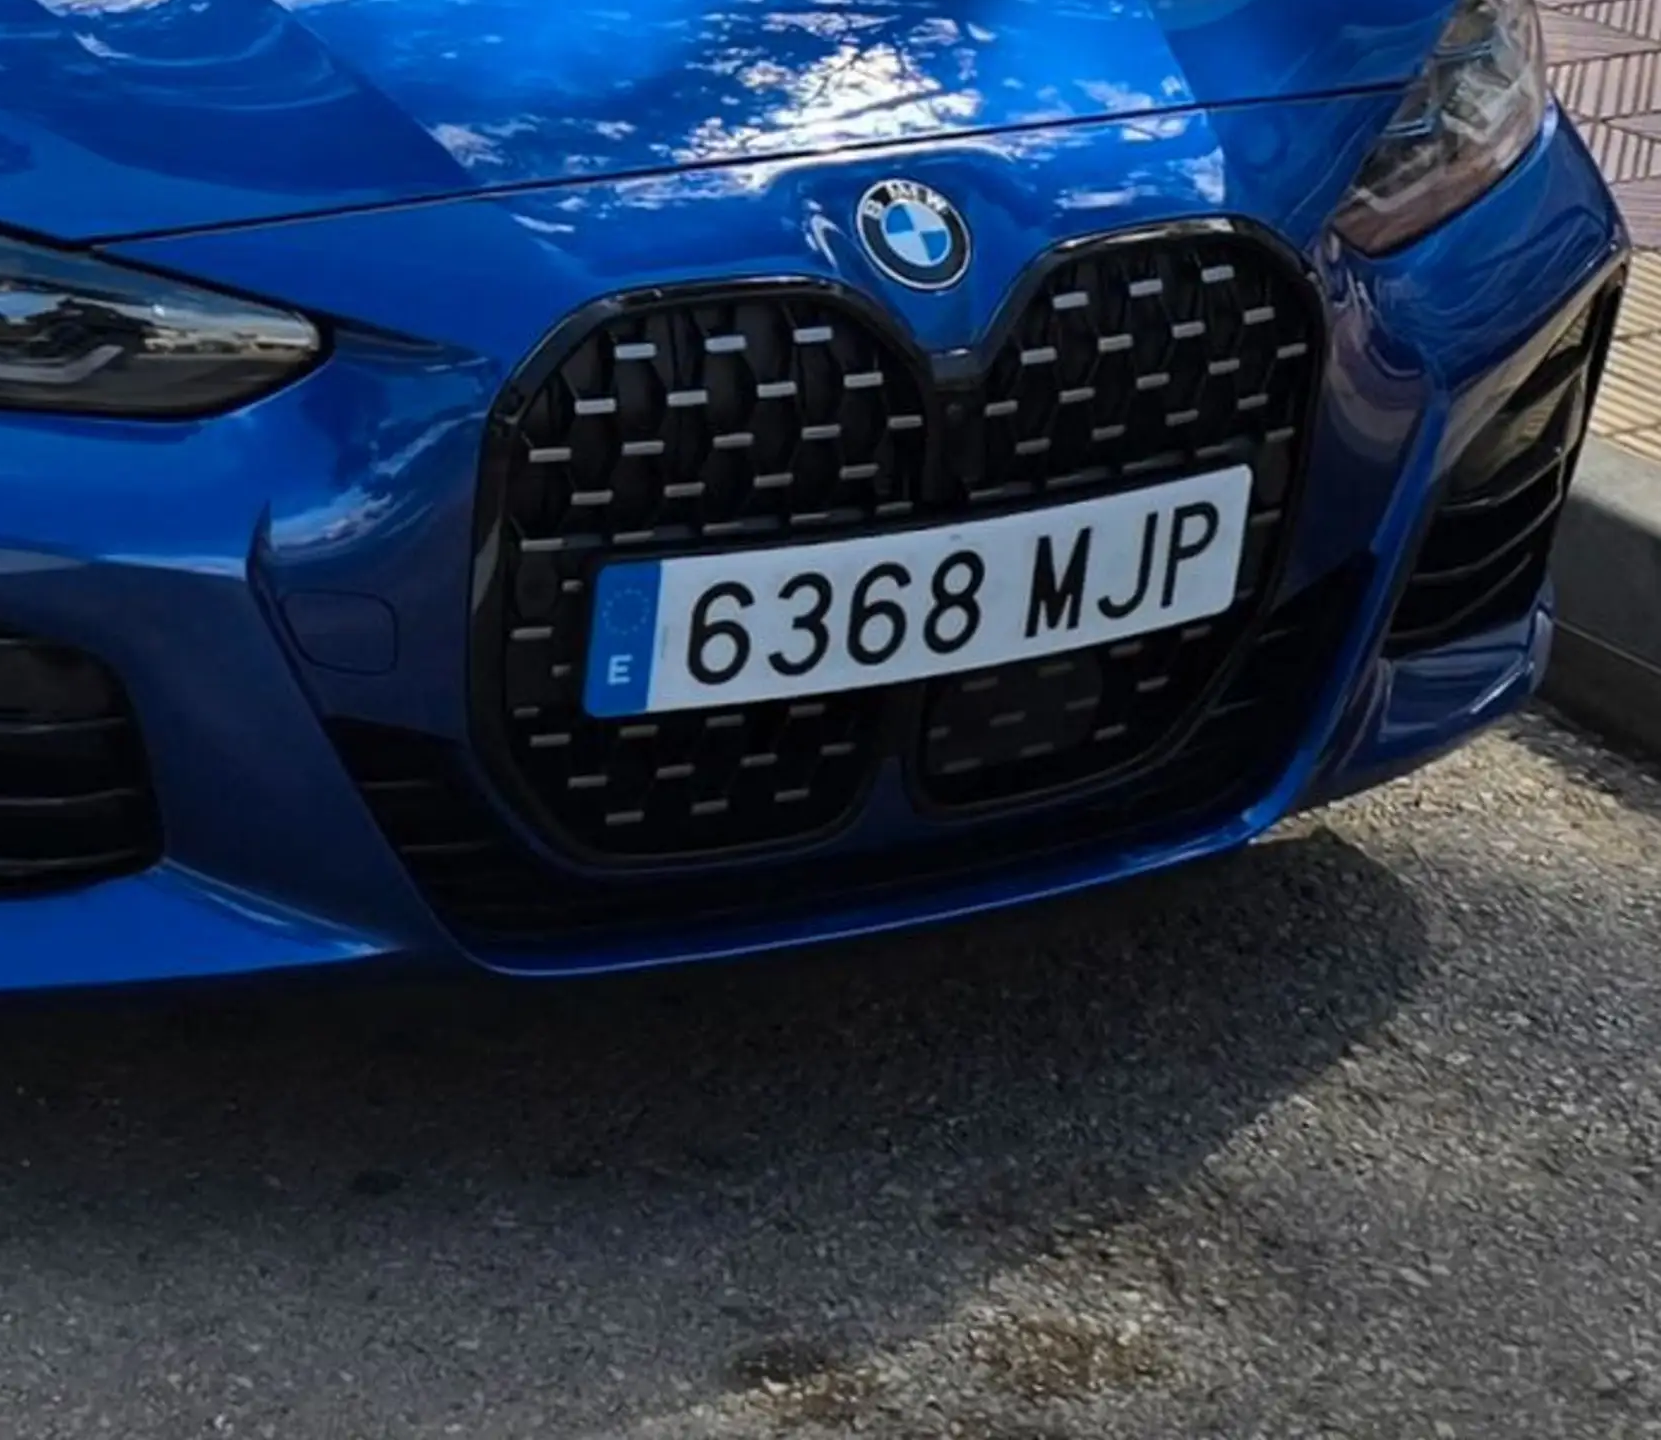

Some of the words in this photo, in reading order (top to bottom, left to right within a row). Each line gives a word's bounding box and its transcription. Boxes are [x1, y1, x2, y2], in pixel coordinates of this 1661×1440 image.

[863, 181, 950, 220] BMW
[686, 550, 986, 686] 6368
[1024, 501, 1220, 639] MJP
[607, 653, 633, 685] E
